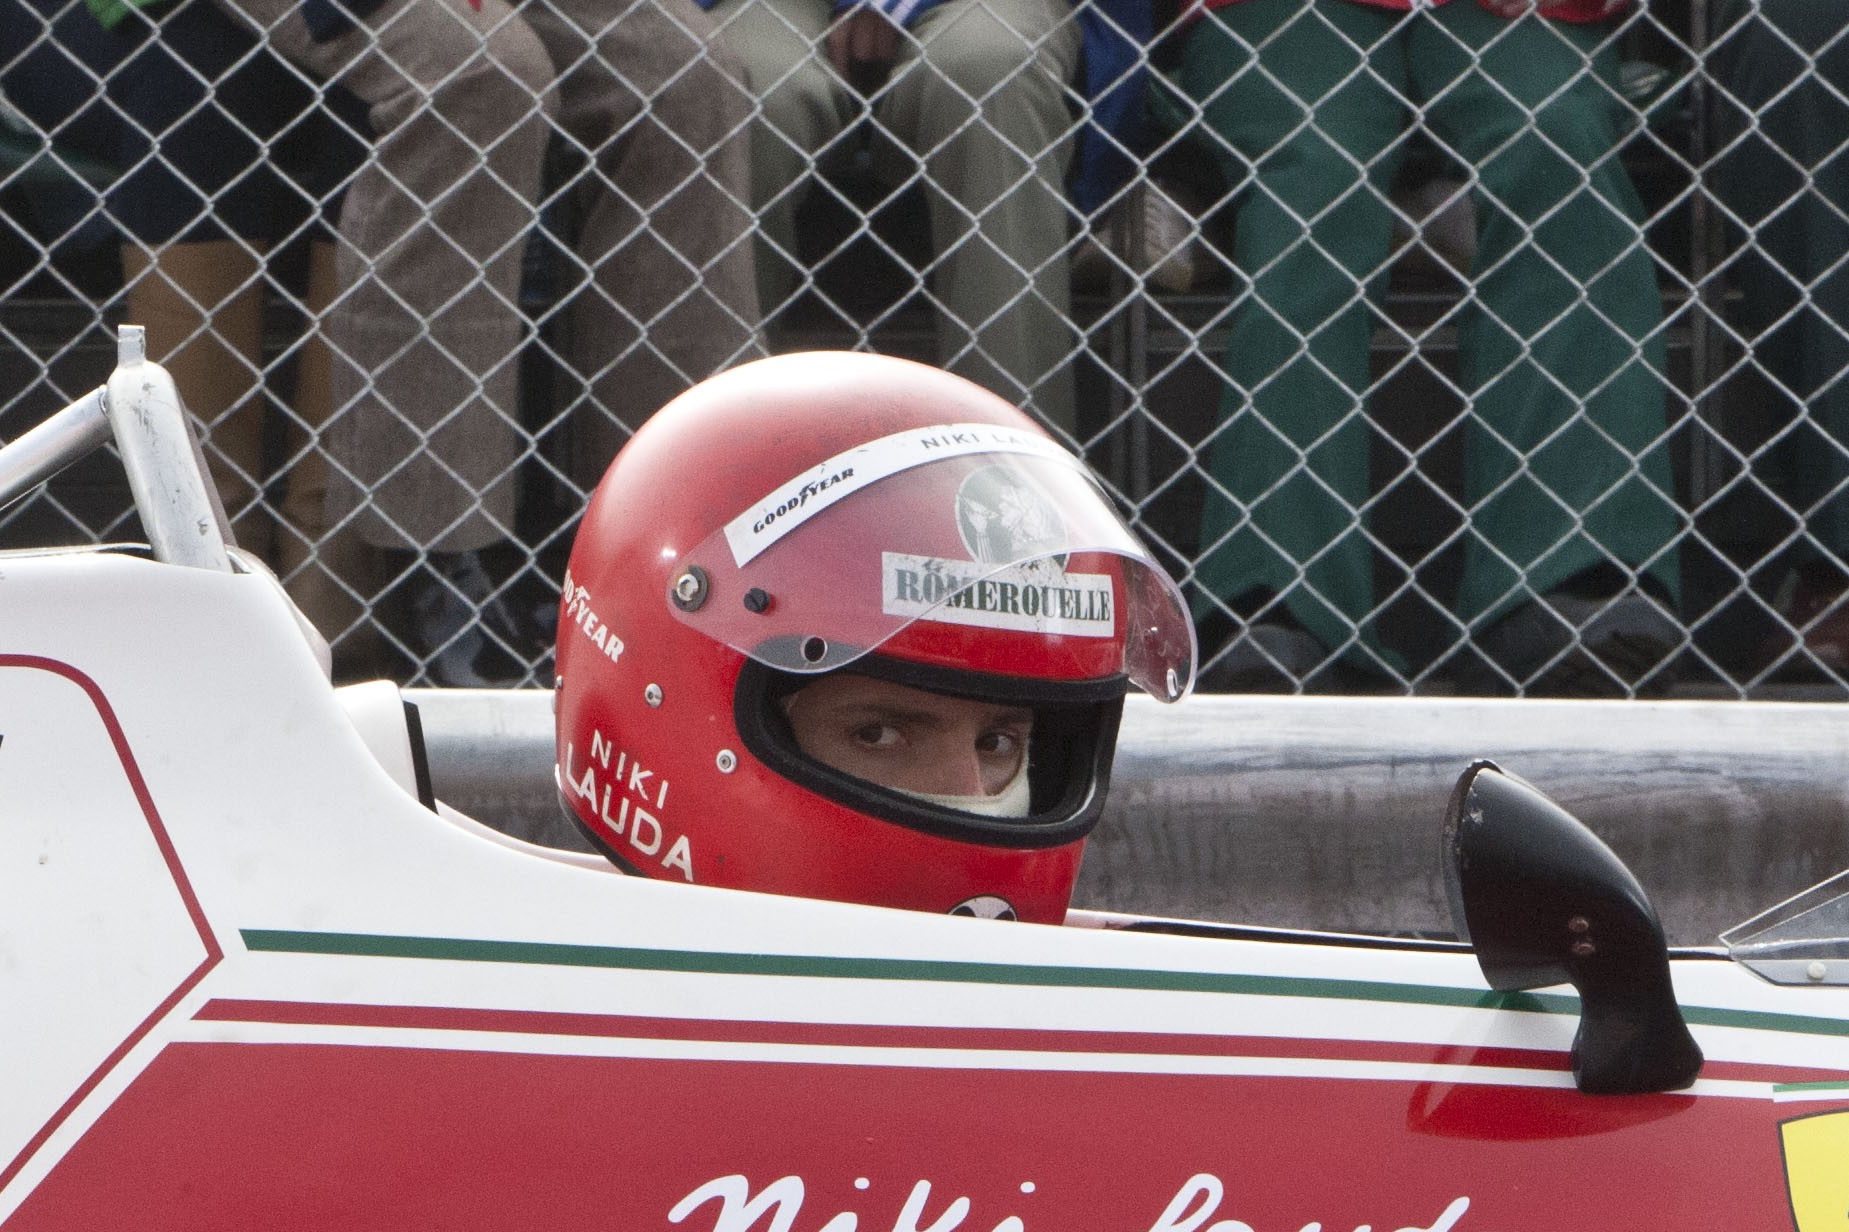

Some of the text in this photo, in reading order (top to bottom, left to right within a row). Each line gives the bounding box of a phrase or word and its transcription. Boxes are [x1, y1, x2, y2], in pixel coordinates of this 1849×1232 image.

[920, 432, 980, 451] NIKI
[752, 466, 855, 536] GOODYEAR
[590, 728, 670, 811] NIKI
[565, 741, 695, 883] LAUDA
